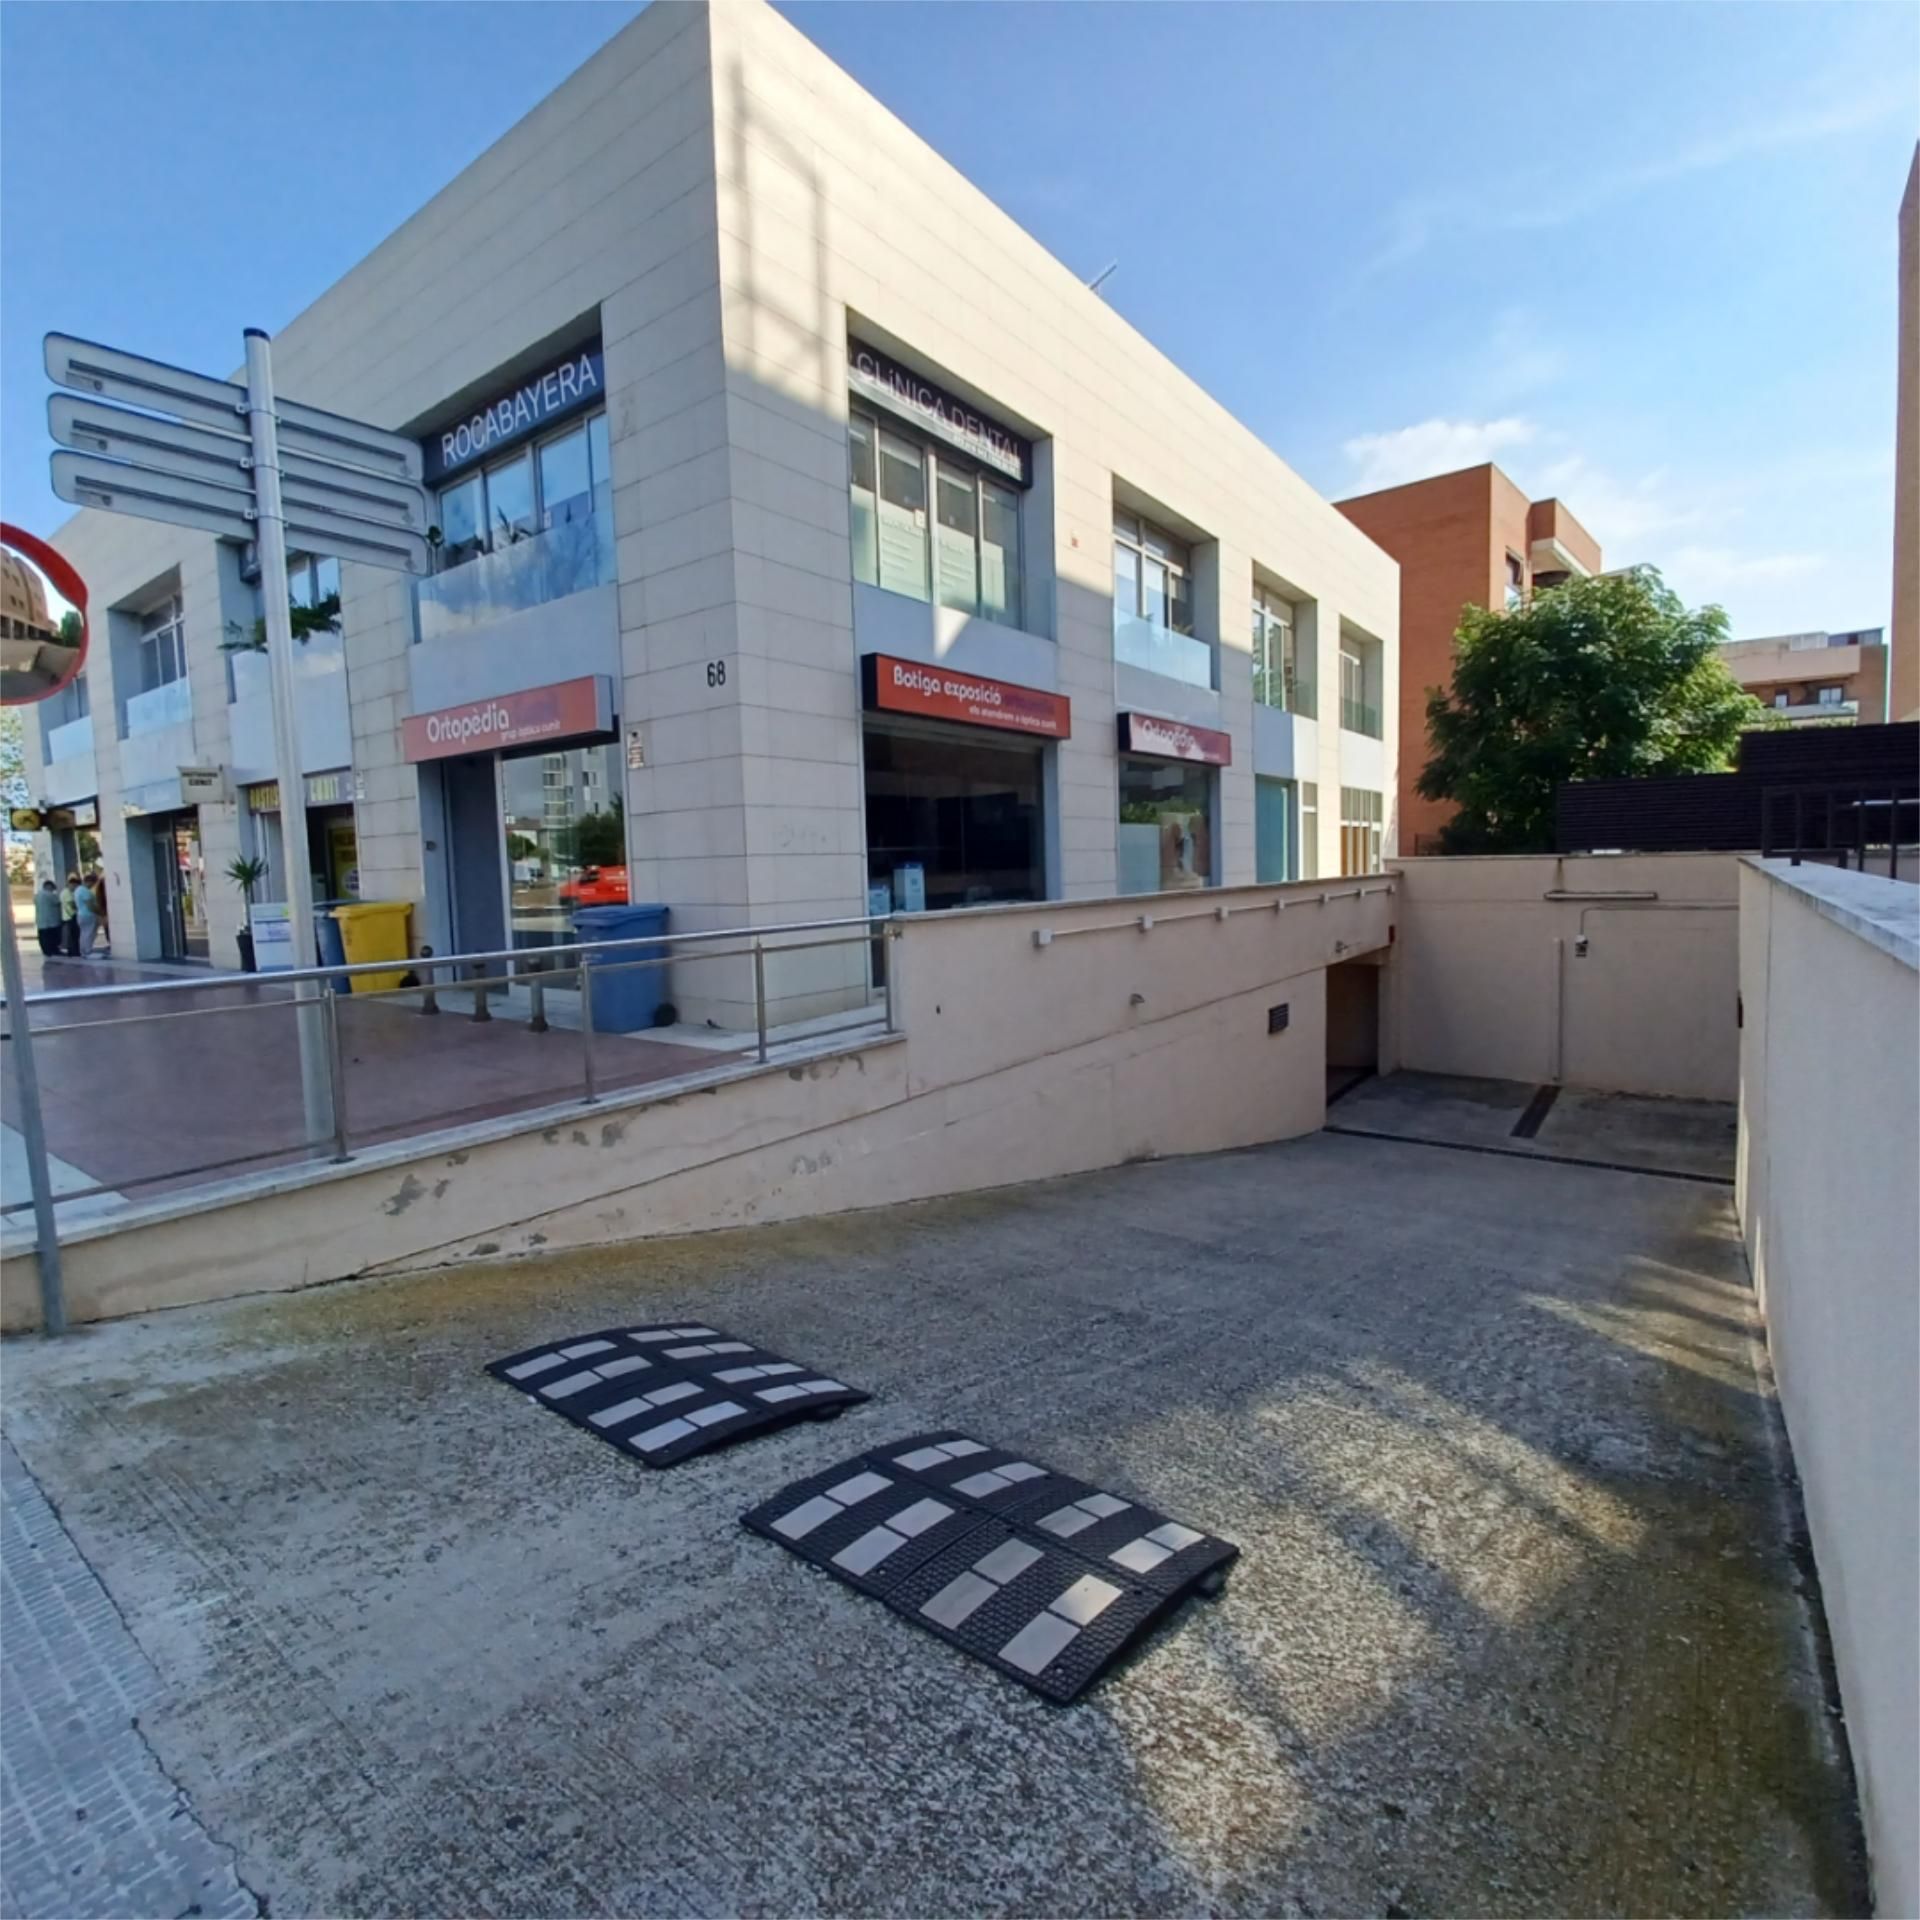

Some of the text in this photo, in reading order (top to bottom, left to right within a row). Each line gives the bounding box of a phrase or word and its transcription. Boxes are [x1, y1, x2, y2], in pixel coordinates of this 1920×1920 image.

[441, 353, 598, 468] ROCABAYERA
[707, 660, 726, 688] 68
[893, 665, 1002, 705] Botiga exposició
[426, 704, 510, 744] Ortopèdia
